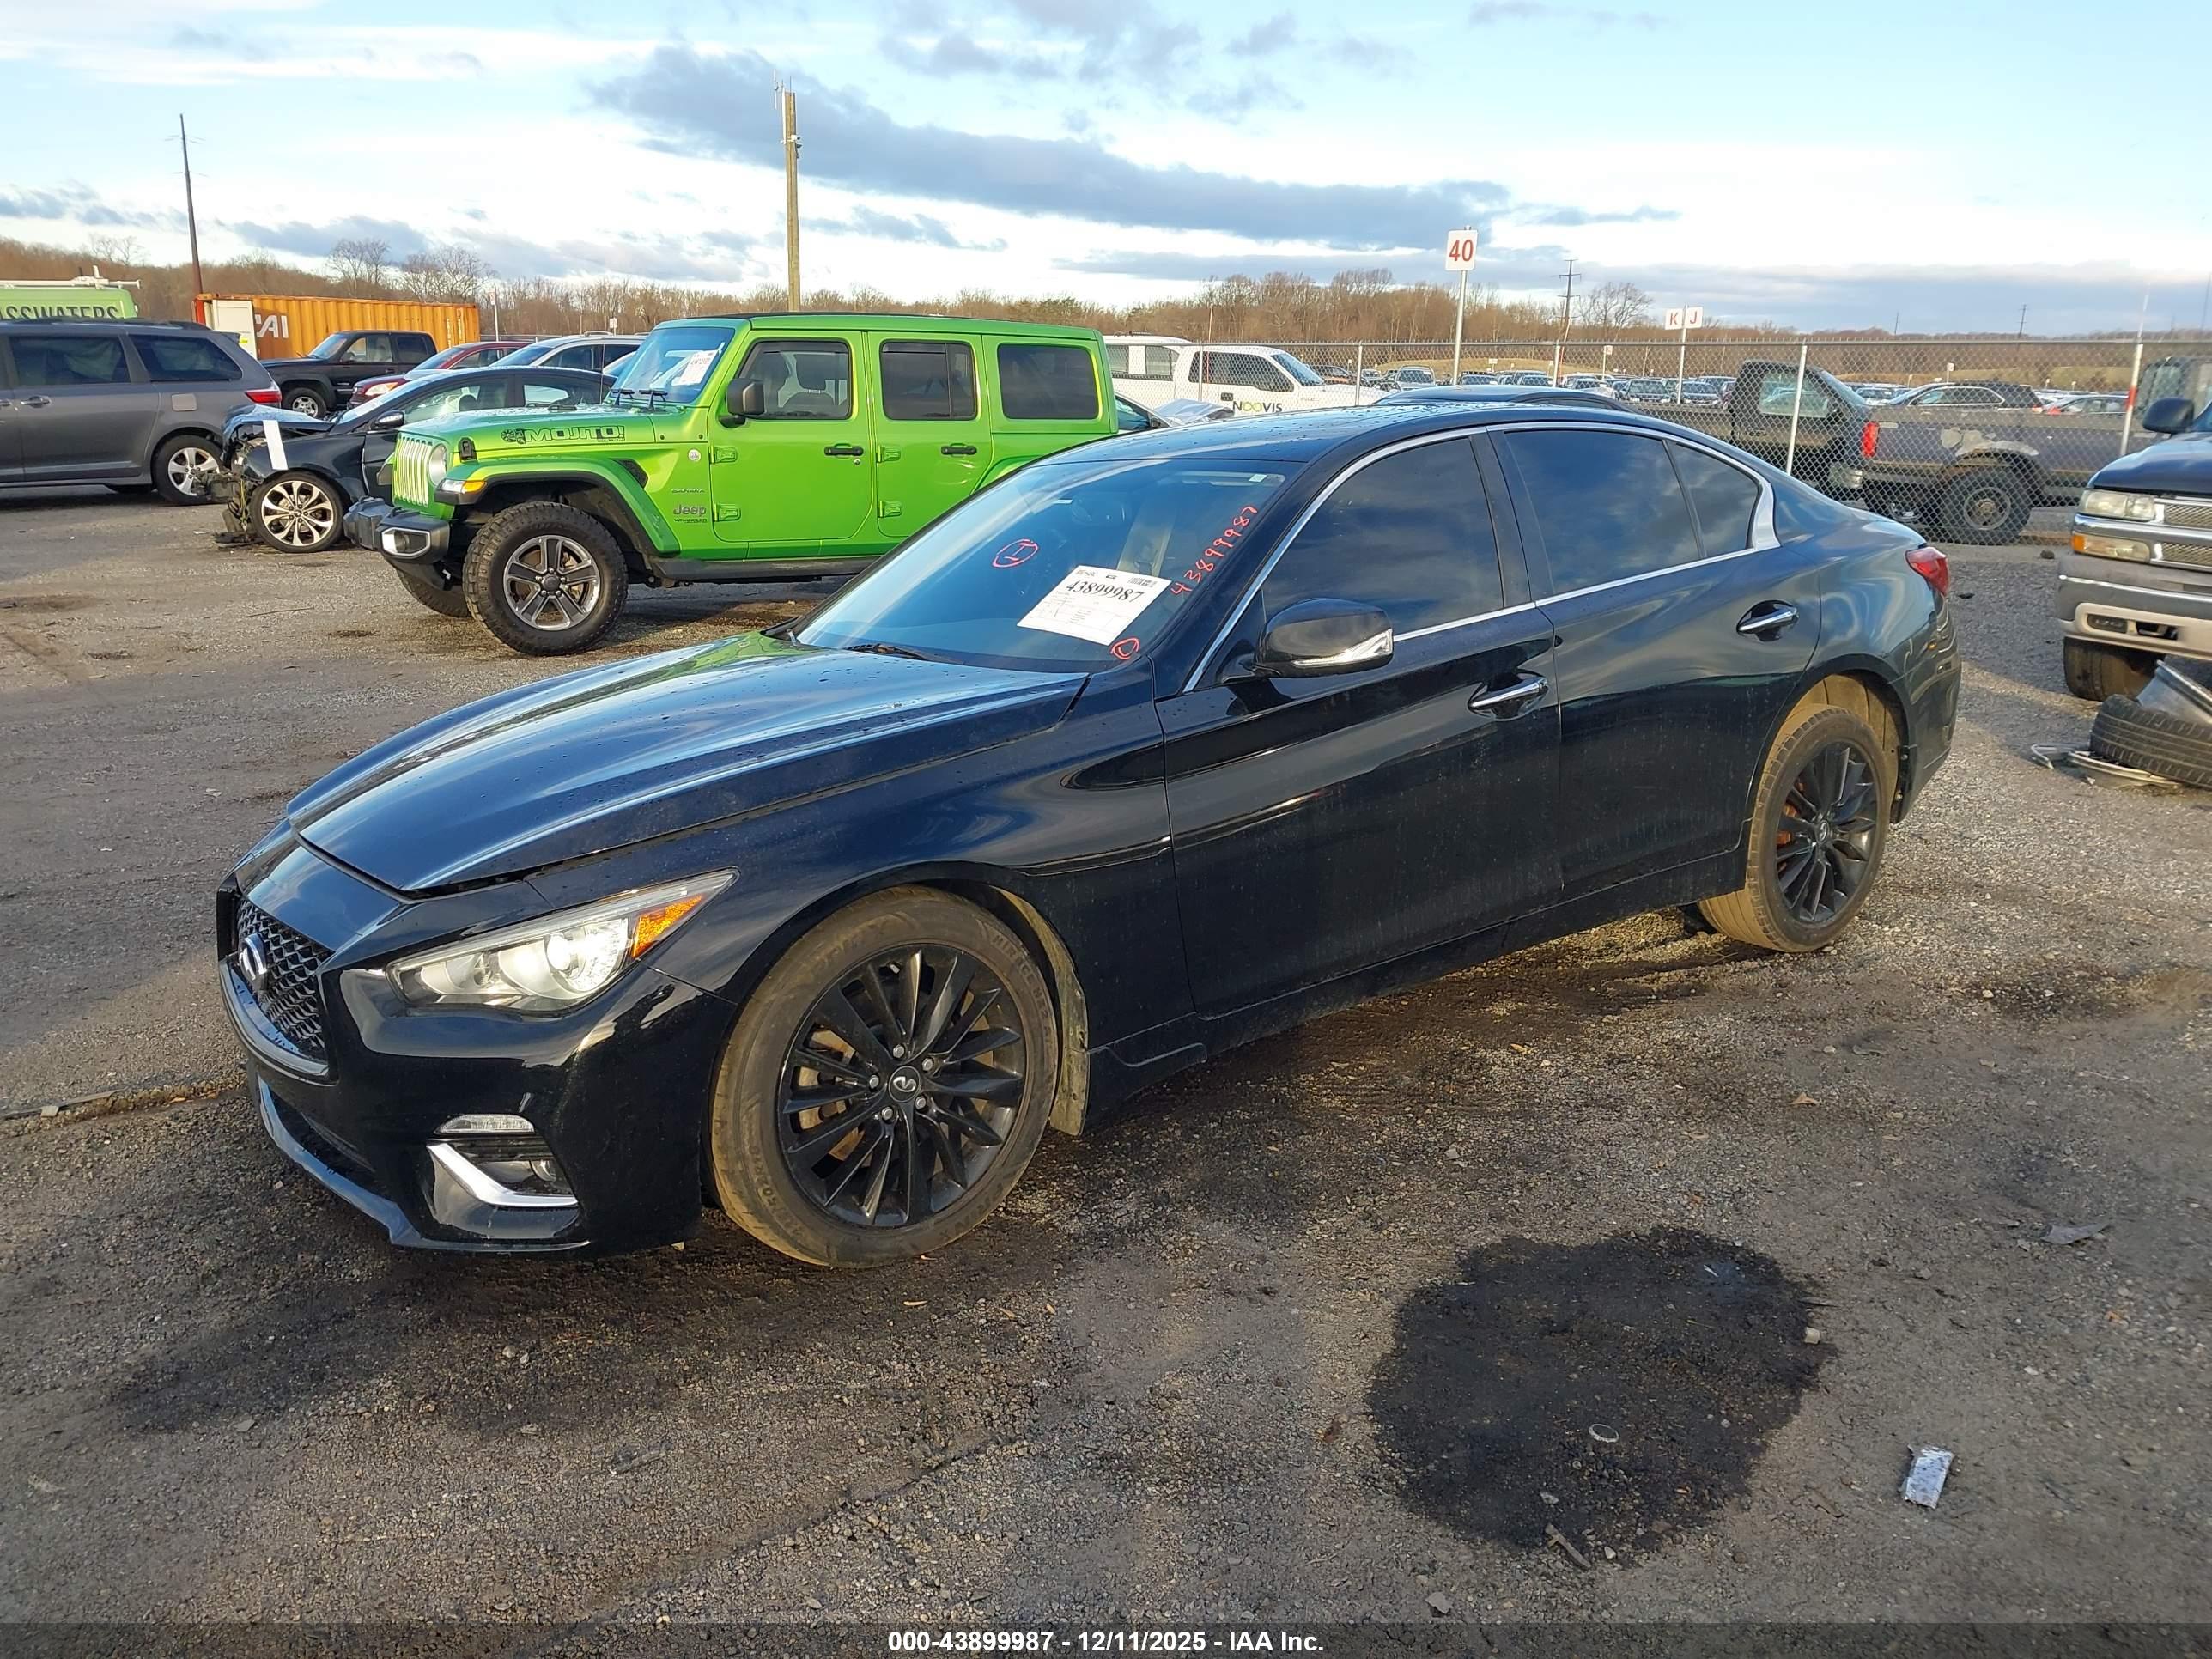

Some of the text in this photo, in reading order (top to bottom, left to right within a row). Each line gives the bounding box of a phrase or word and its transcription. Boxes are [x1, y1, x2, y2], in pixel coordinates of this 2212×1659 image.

[1449, 240, 1474, 262] 40
[0, 305, 118, 320] SSWATERS
[1669, 312, 1678, 326] K
[1689, 311, 1698, 325] J
[254, 313, 289, 338] AI
[672, 504, 707, 517] Jeep
[1170, 507, 1258, 594] 43899987
[1066, 580, 1145, 603] 43899987
